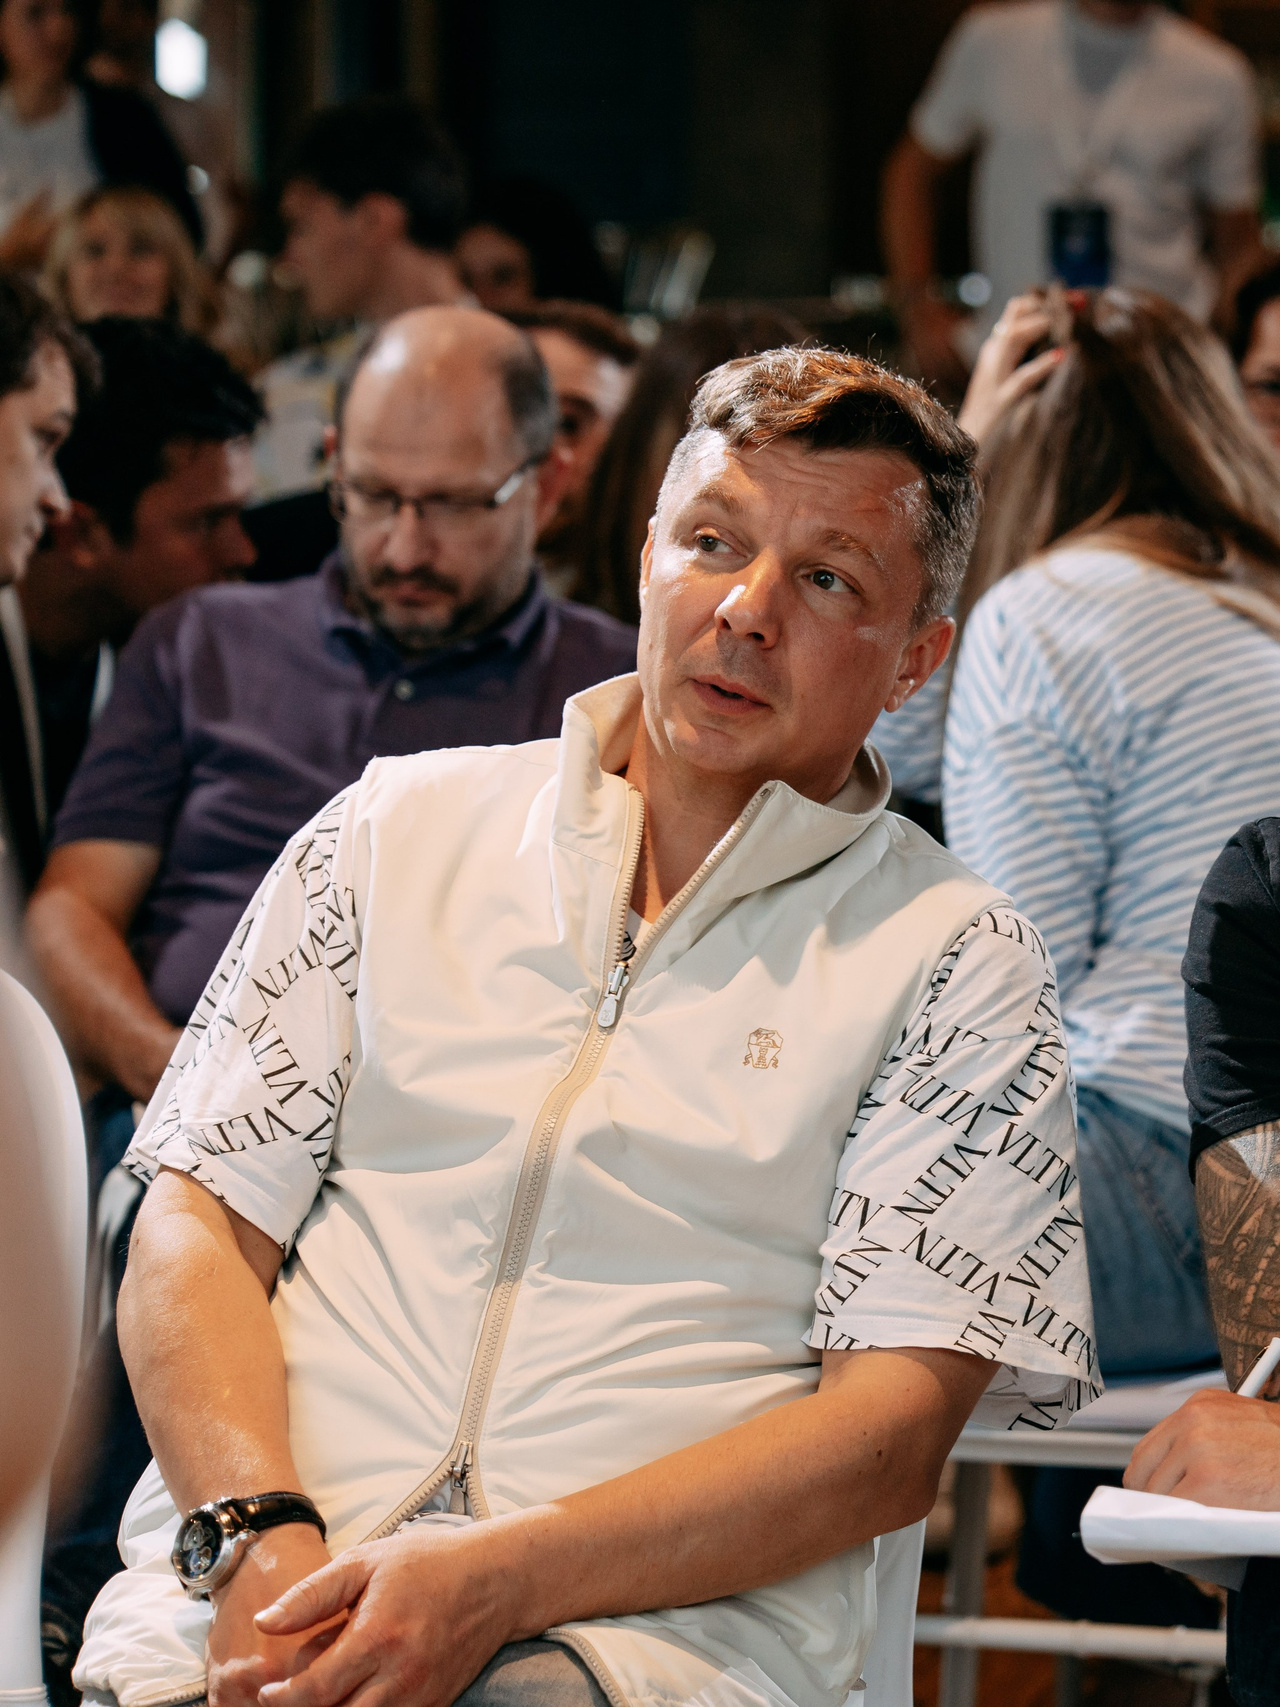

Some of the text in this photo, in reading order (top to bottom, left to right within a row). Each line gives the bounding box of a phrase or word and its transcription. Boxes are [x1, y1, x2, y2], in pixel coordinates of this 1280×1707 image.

[252, 927, 326, 1010] VLTN
[970, 911, 1046, 965] LTN
[241, 1012, 308, 1109] VLTN
[987, 1031, 1067, 1117] VLTN
[187, 1106, 301, 1162] VLTN
[899, 1074, 987, 1138] VLTN
[890, 1143, 993, 1227] VLTN
[997, 1121, 1078, 1203] VLTN
[817, 1235, 894, 1318] VLTN
[899, 1226, 1000, 1307] VLTN
[1004, 1205, 1083, 1290] VLTN
[1022, 1292, 1097, 1377] VLTN
